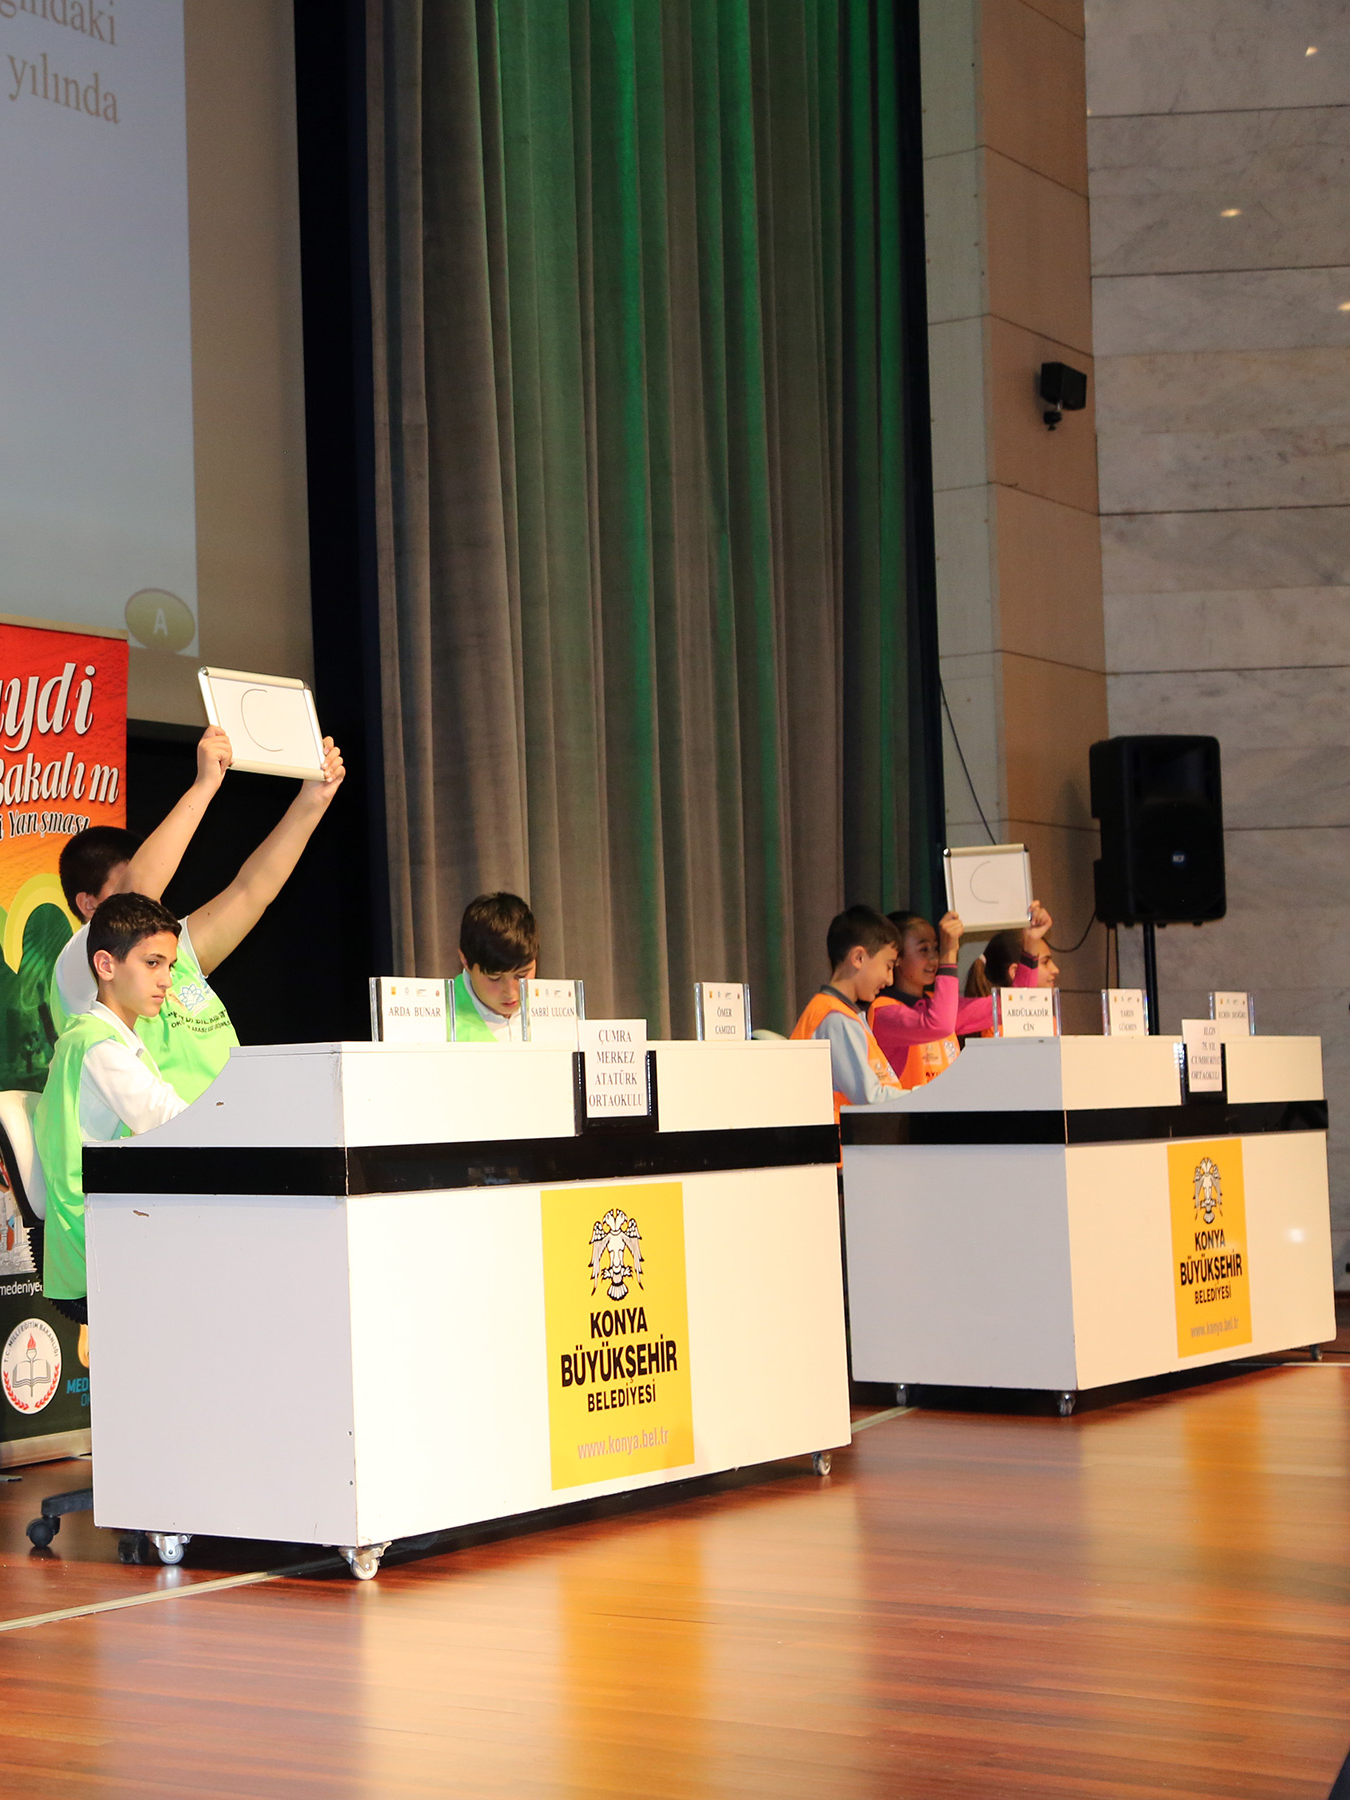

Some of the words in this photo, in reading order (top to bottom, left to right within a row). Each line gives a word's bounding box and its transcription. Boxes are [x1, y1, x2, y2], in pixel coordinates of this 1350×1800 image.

[7, 53, 121, 125] yılında
[152, 607, 169, 637] A
[240, 688, 284, 753] C
[8, 809, 90, 838] Yarışması
[969, 860, 1000, 905] C
[388, 1007, 411, 1017] ARDA
[598, 1029, 632, 1045] ÇUMRA
[596, 1050, 635, 1064] MERKEZ
[595, 1069, 638, 1085] ATATÜRK
[588, 1093, 643, 1107] ORTAOKULU
[1194, 1229, 1226, 1251] KONYA
[1180, 1249, 1242, 1287] BÜYÜKŞEHİR
[1194, 1281, 1232, 1304] BELEDİYESİ
[590, 1306, 649, 1339] KONYA
[560, 1333, 679, 1388] BÜYÜKŞEHİR
[66, 1378, 90, 1394] MED
[587, 1378, 658, 1413] BELEDİYESİ
[577, 1426, 670, 1460] www.konya.bel.tr
